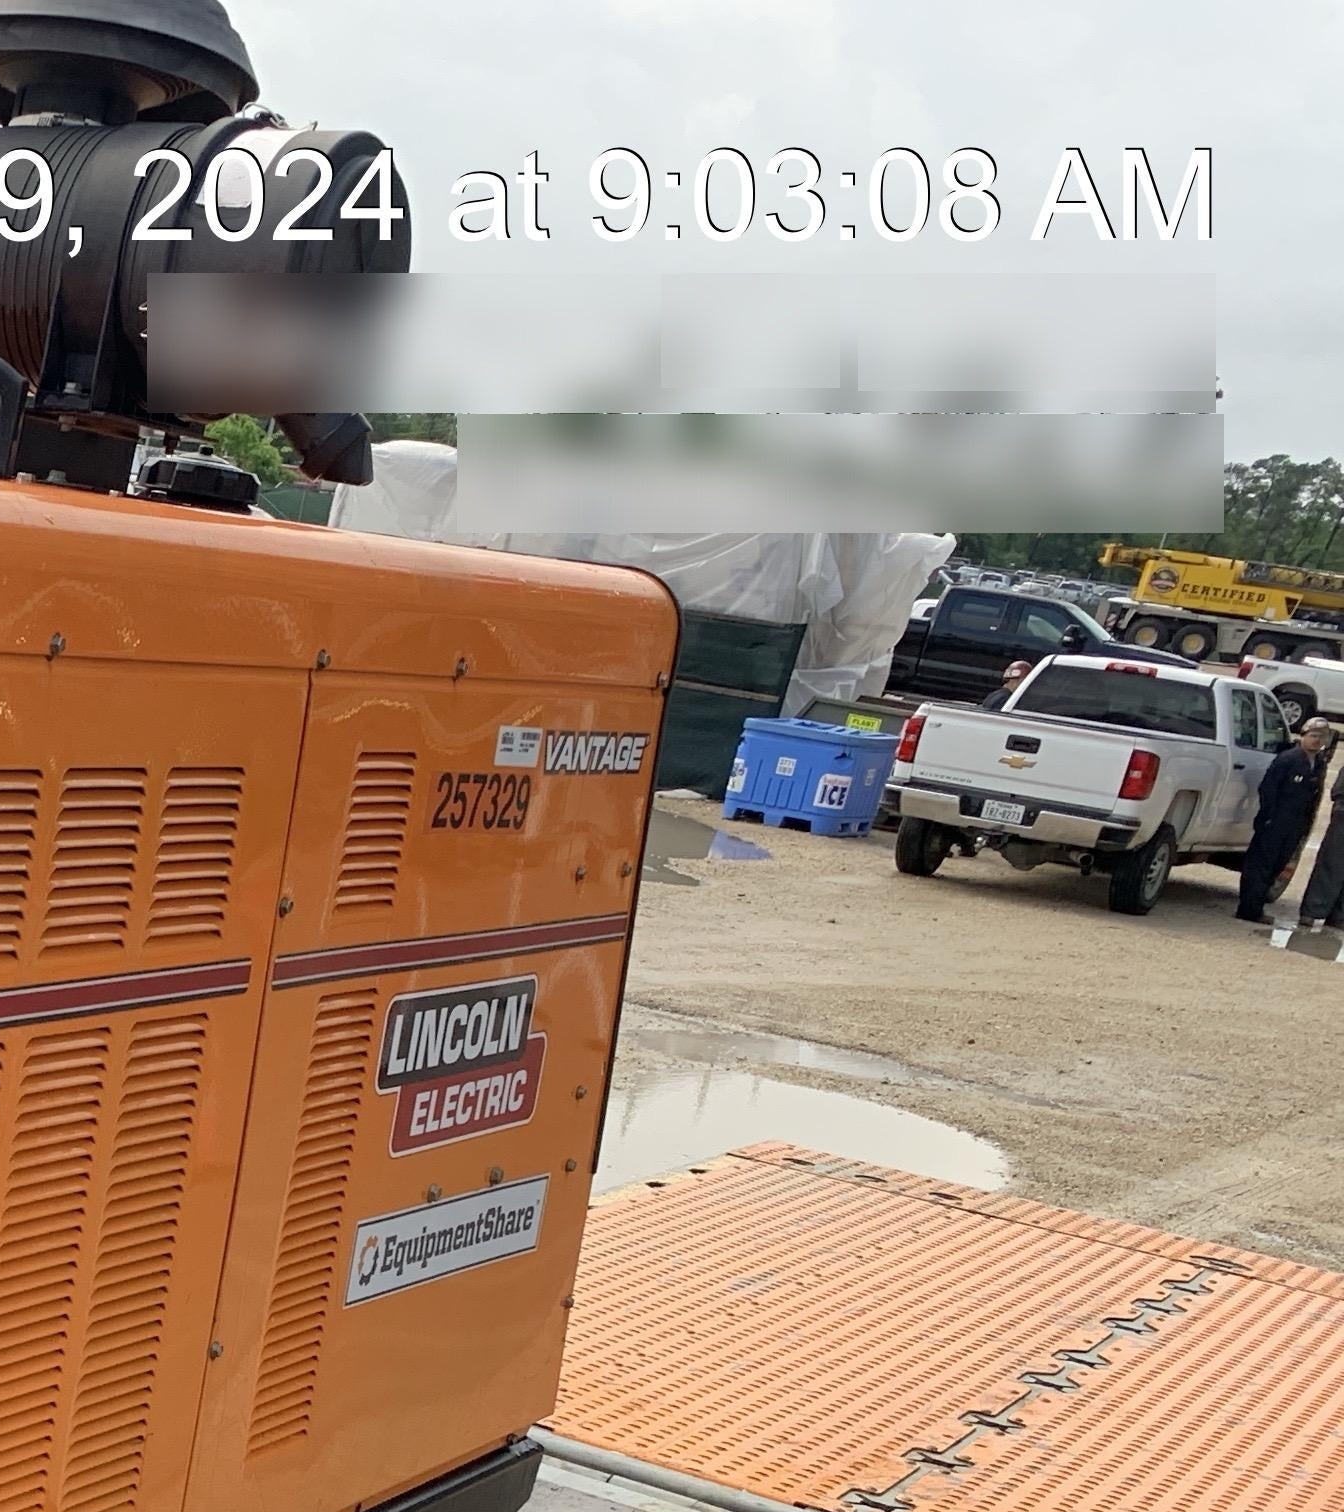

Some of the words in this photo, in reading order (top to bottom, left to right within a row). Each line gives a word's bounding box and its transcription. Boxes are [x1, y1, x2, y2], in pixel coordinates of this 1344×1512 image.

[1181, 583, 1266, 603] CERTIFIED
[545, 731, 650, 773] VANTAGE
[431, 772, 532, 830] 257329
[820, 784, 848, 806] ICE
[386, 993, 529, 1077] LINCOLN
[409, 1069, 528, 1137] ELECTRIC
[380, 1205, 535, 1276] EquipmentShare
